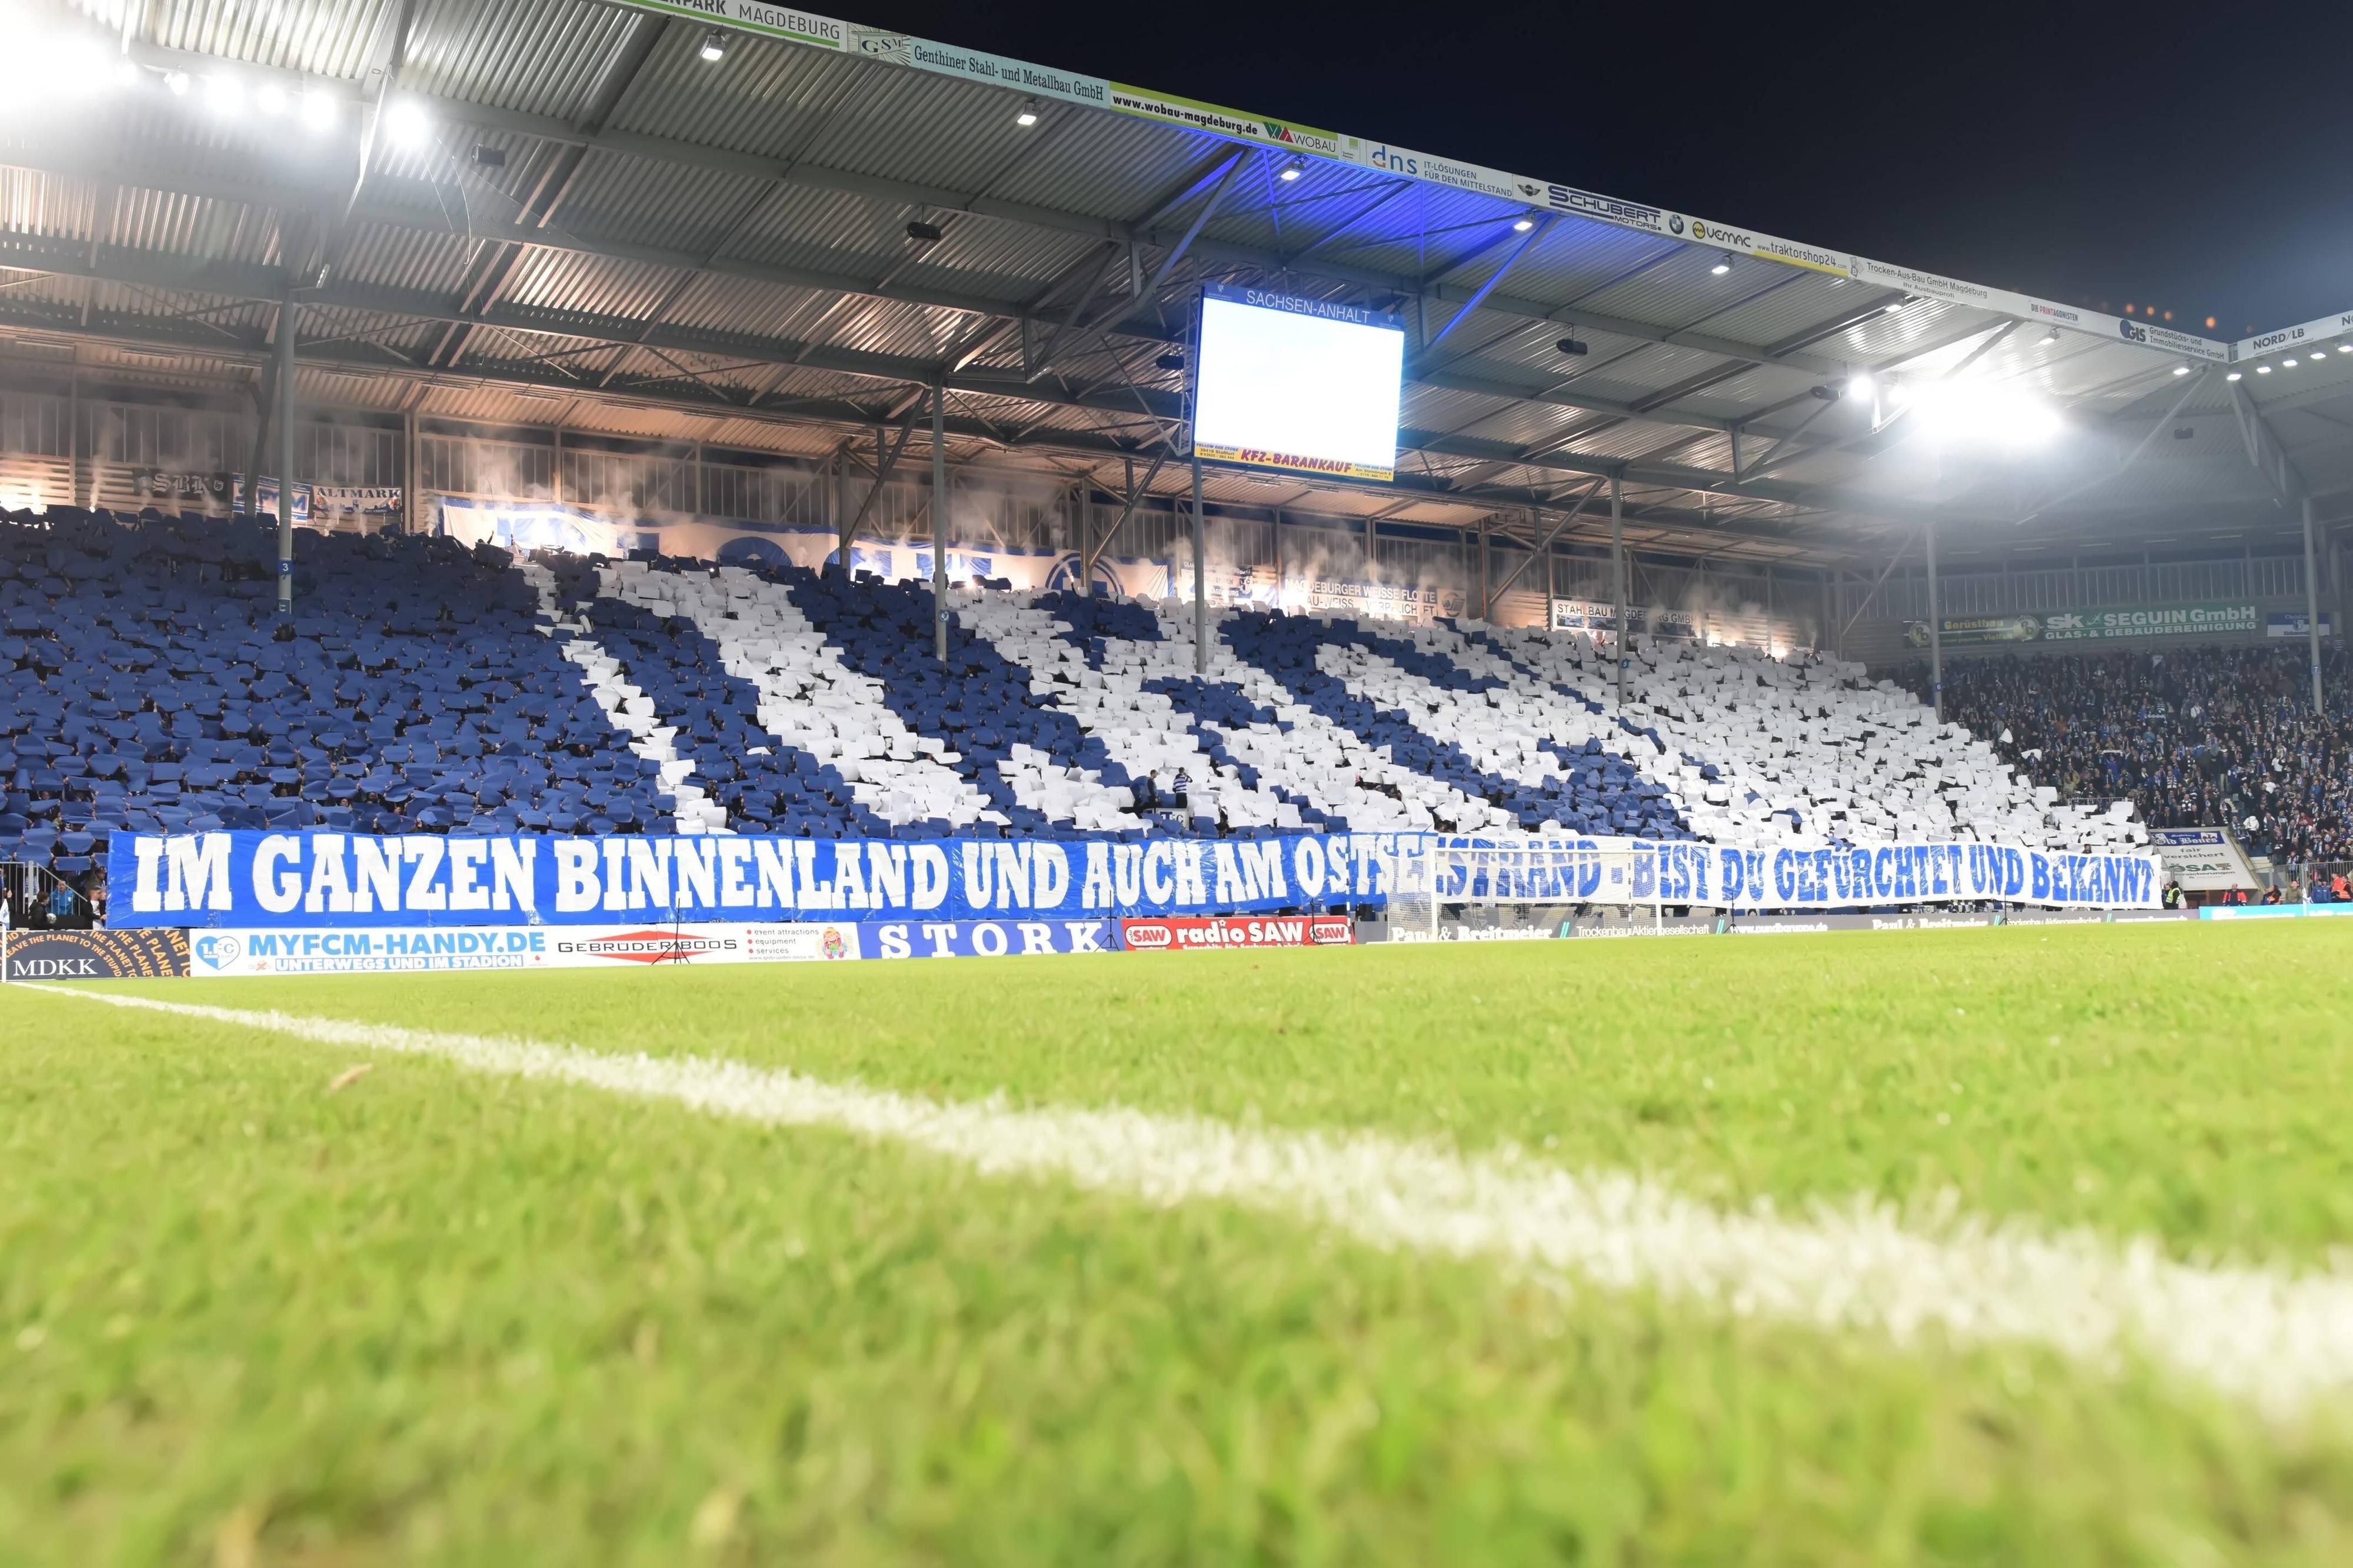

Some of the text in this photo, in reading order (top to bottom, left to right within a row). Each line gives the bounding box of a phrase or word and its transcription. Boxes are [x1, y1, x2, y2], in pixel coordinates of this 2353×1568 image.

[739, 5, 840, 39] MAGDEBURG
[862, 37, 902, 54] GSM
[914, 45, 1104, 101] Genthiner Stahl- und Metallbau GmbH
[1112, 95, 1258, 135] www.wobau-magdeburg.de
[1294, 133, 1337, 152] WOBAU
[1372, 145, 1418, 175] dns
[1424, 160, 1477, 180] IT-LÖSUNGEN
[1424, 169, 1512, 197] FÜR DEN MITTELSTAND
[1548, 185, 1661, 223] SCHUBERT
[1614, 215, 1658, 231] MOTORS
[1867, 262, 1925, 283] Trocken-Aus-Bau
[1927, 276, 1948, 289] GmbH
[1949, 281, 1988, 299] Magdeburg
[1246, 289, 1371, 325] SACHSEN-ANHALT
[2031, 303, 2039, 312] DIE
[2129, 326, 2147, 342] GIS
[2149, 326, 2189, 342] Grundstücks-
[2252, 328, 2305, 350] NORD/LB
[2206, 349, 2224, 359] GmbH
[1240, 448, 1352, 473] KFZ-BARANKAUF
[316, 486, 401, 499] ALTMARK
[282, 563, 289, 572] 3
[1363, 585, 1399, 599] WEISSE
[1944, 619, 2004, 630] Gerüstbau
[2046, 606, 2256, 630] sk SEGUIN GmbH
[2045, 621, 2257, 640] GLAS- & GEBÄUDEREINIGUNG
[132, 833, 232, 912] IM
[252, 833, 536, 913] GANZEN
[553, 838, 949, 912] BINNENLAND
[961, 841, 1070, 909] UND
[1082, 840, 1207, 909] AUCH
[1213, 839, 1288, 905] AM
[1632, 840, 1712, 900] BIST
[1720, 848, 1766, 902] DU
[1773, 844, 1964, 902] GEFÜRCHTET
[1968, 844, 2025, 896] UND
[2030, 852, 2154, 903] BEKANNT
[2168, 863, 2218, 872] ÖSA
[1176, 919, 1304, 944] radio SAW
[1315, 926, 1345, 940] SAW
[1439, 926, 1453, 941] &
[1457, 925, 1553, 940] Breitmeier
[1576, 926, 1629, 937] Trockenbau
[1908, 919, 1917, 928] &
[248, 931, 546, 957] MYFCM-HANDY.DE
[681, 939, 737, 950] BOOS
[878, 922, 1103, 959] STORK
[1134, 929, 1166, 943] SAW
[28, 935, 45, 945] THE
[46, 933, 79, 943] PLANET
[79, 938, 91, 948] TO
[91, 943, 106, 957] THE
[103, 954, 122, 977] STUPID
[276, 956, 385, 972] UNTERWEGS
[387, 956, 426, 971] UND
[428, 956, 451, 969] IM
[451, 955, 522, 968] STADION
[12, 958, 98, 977] MDKK
